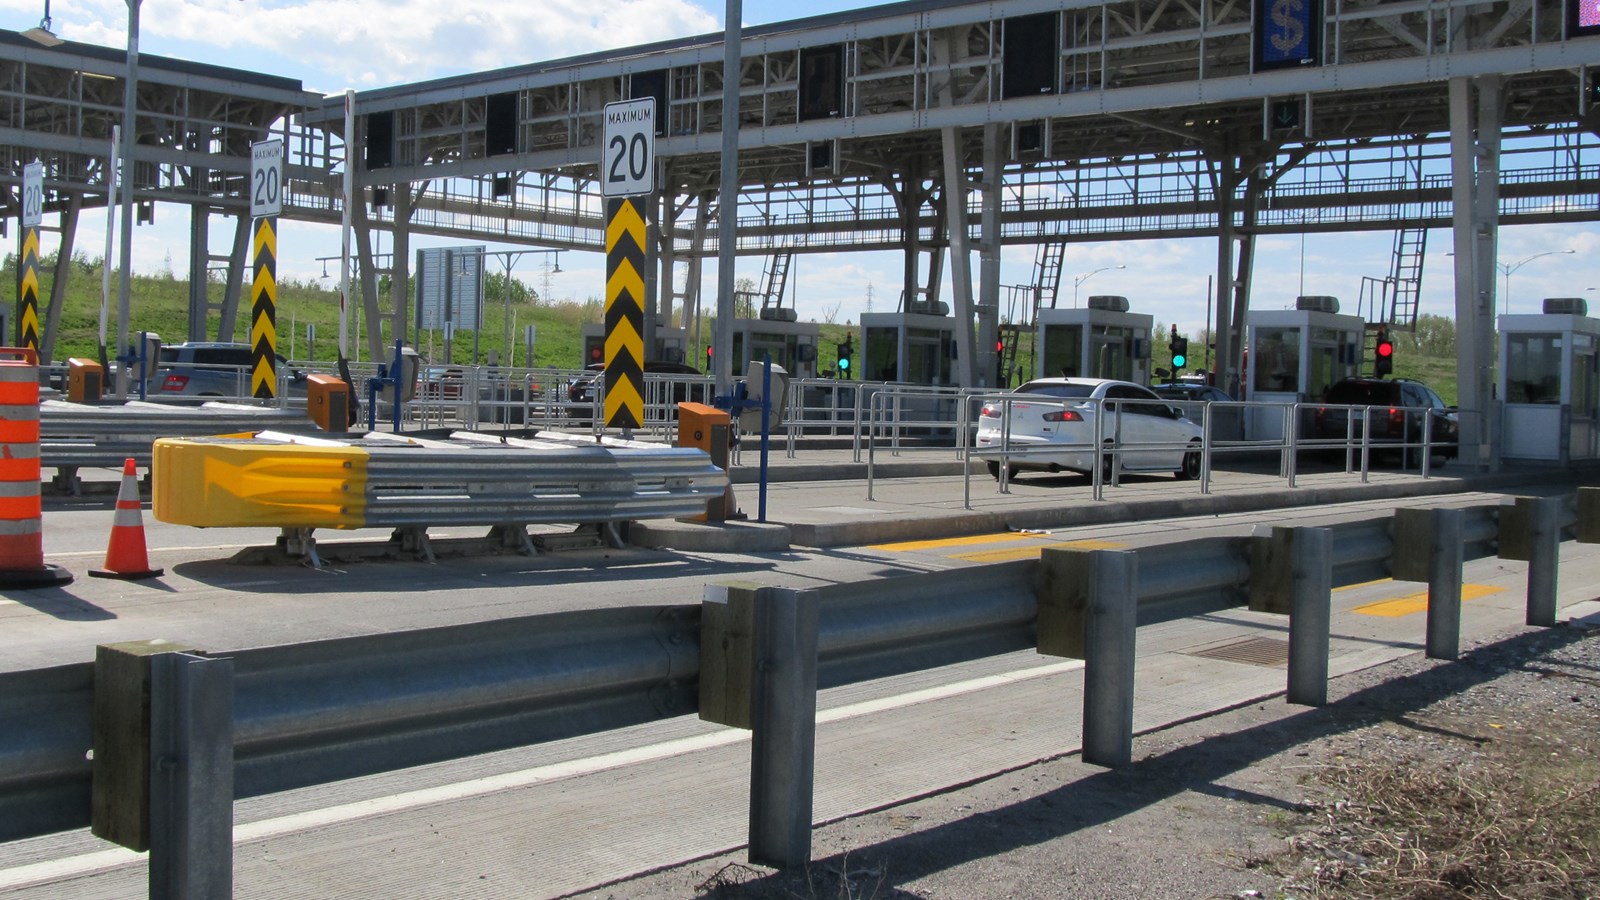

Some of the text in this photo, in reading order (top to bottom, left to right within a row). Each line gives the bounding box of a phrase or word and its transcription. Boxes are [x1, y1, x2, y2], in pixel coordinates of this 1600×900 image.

[1270, 0, 1304, 57] $
[608, 108, 651, 125] MAXIMUM
[254, 147, 280, 160] MAXIMUM
[608, 132, 648, 183] 20
[26, 184, 40, 217] 20
[254, 166, 278, 206] 20
